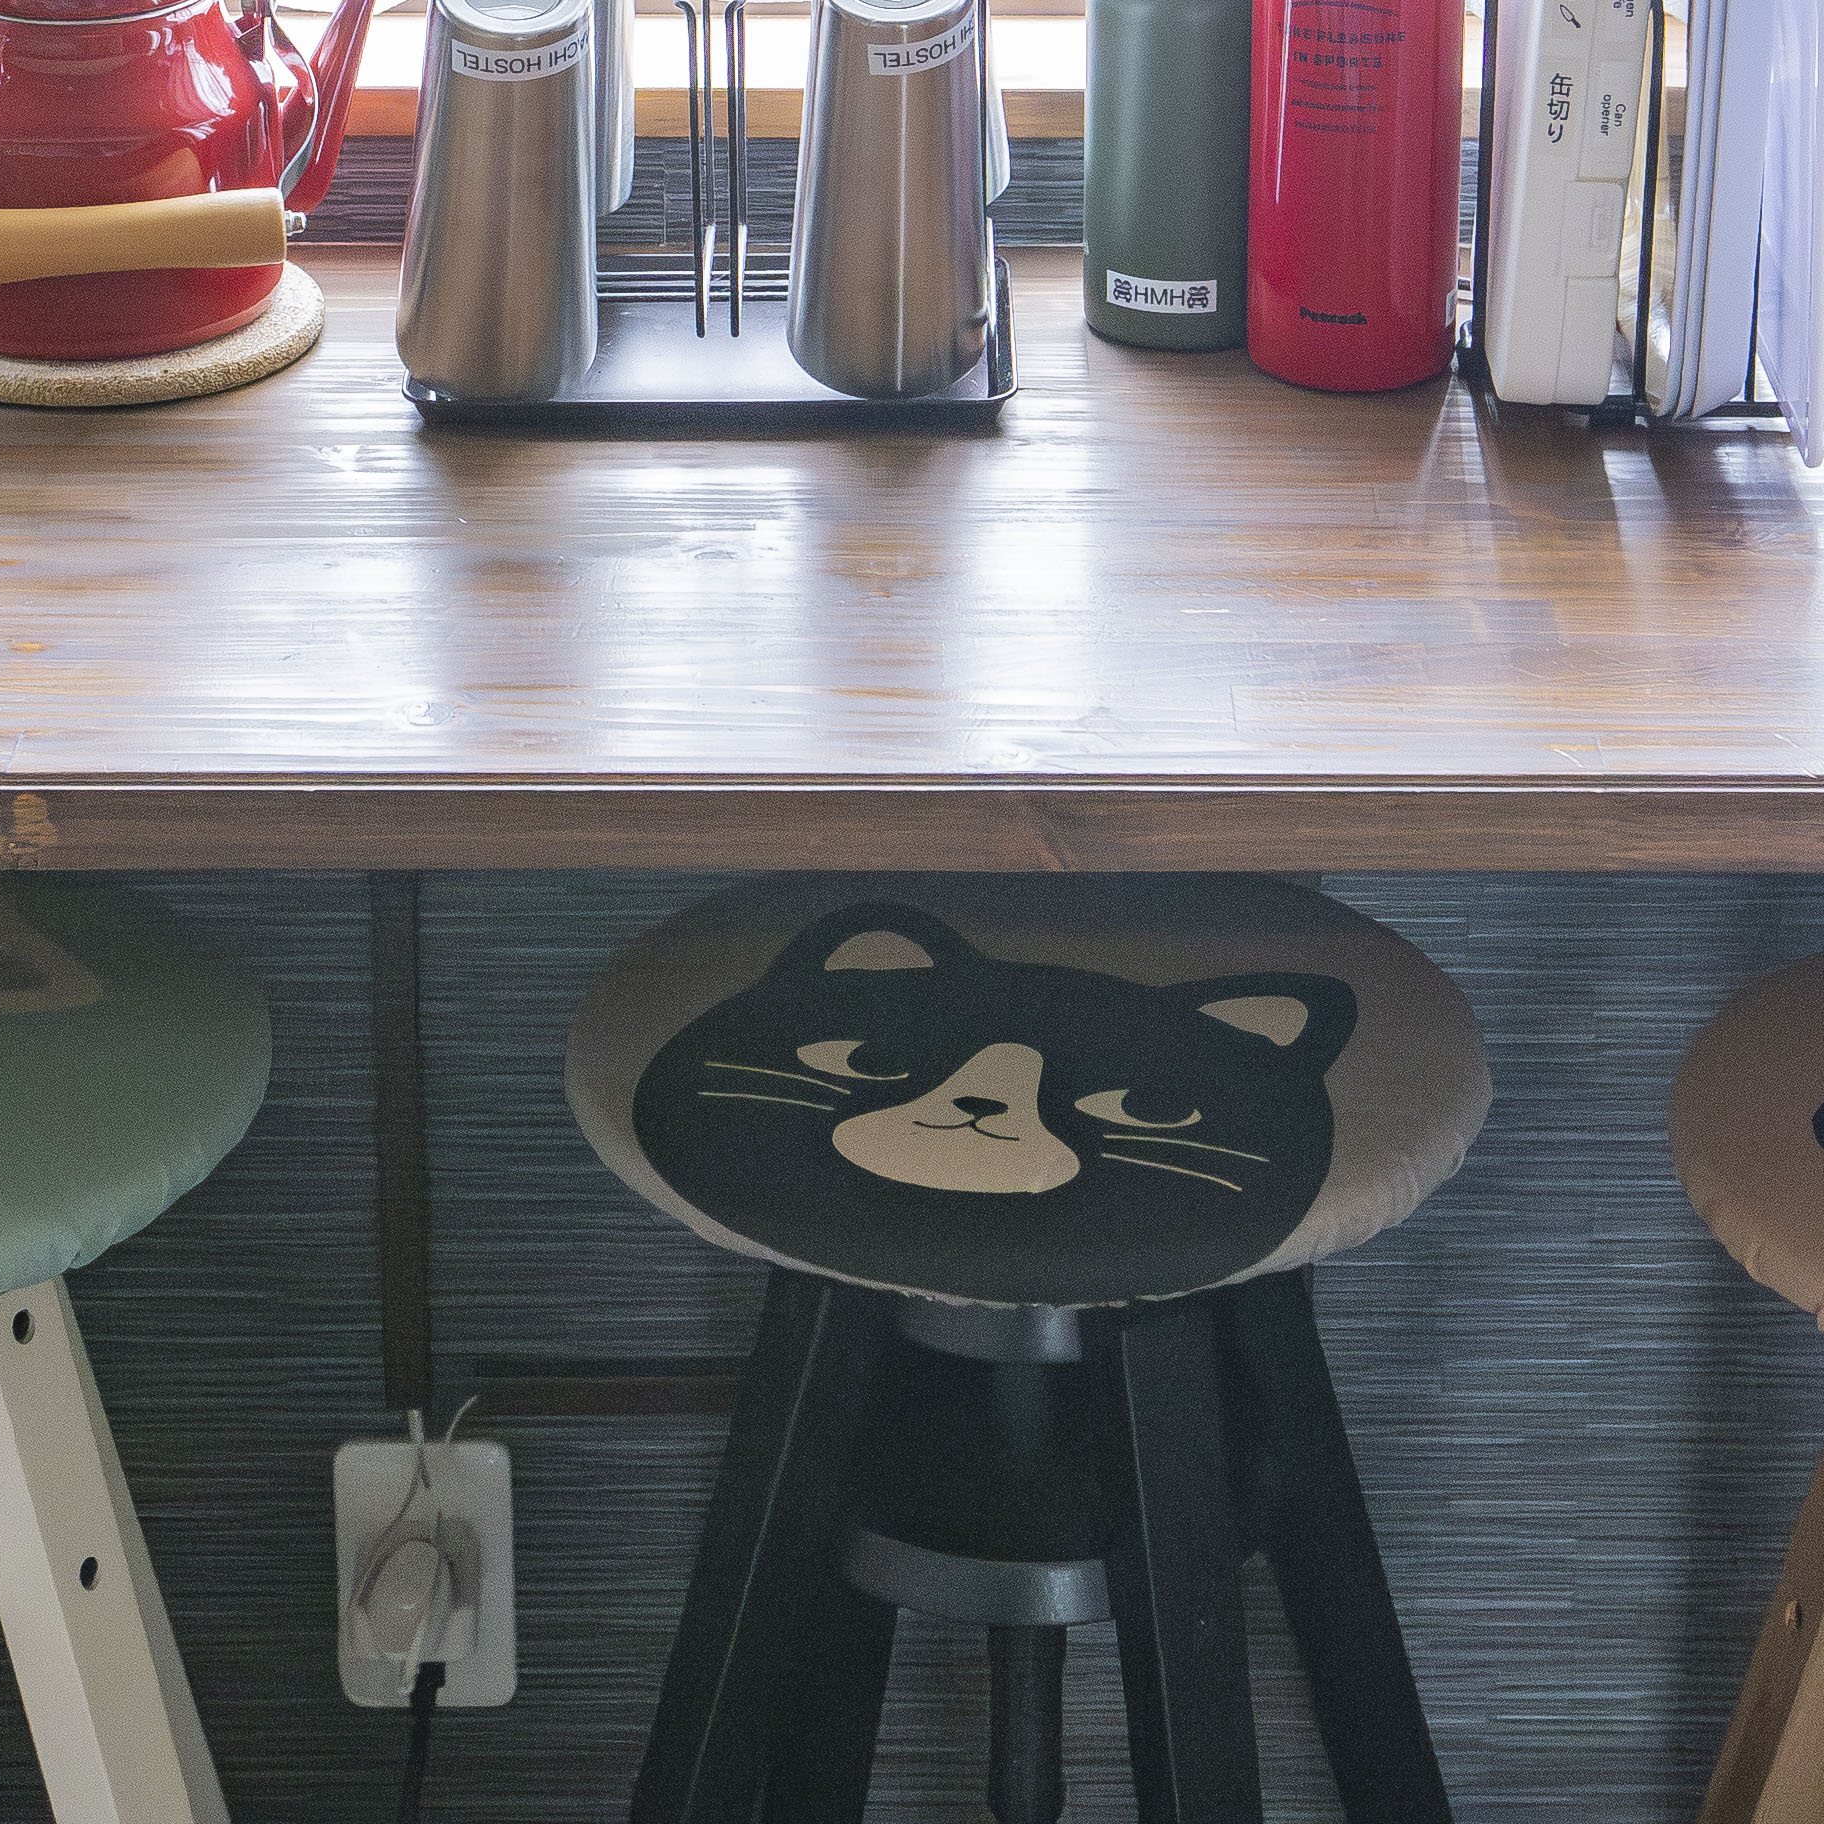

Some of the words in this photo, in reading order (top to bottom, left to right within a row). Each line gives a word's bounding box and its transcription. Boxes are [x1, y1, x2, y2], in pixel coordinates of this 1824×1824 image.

[456, 49, 541, 73] HOSTEL
[874, 35, 957, 68] HOSTEL
[1547, 73, 1573, 144] 缶切り
[1614, 103, 1626, 127] Can
[1134, 284, 1185, 306] HMH
